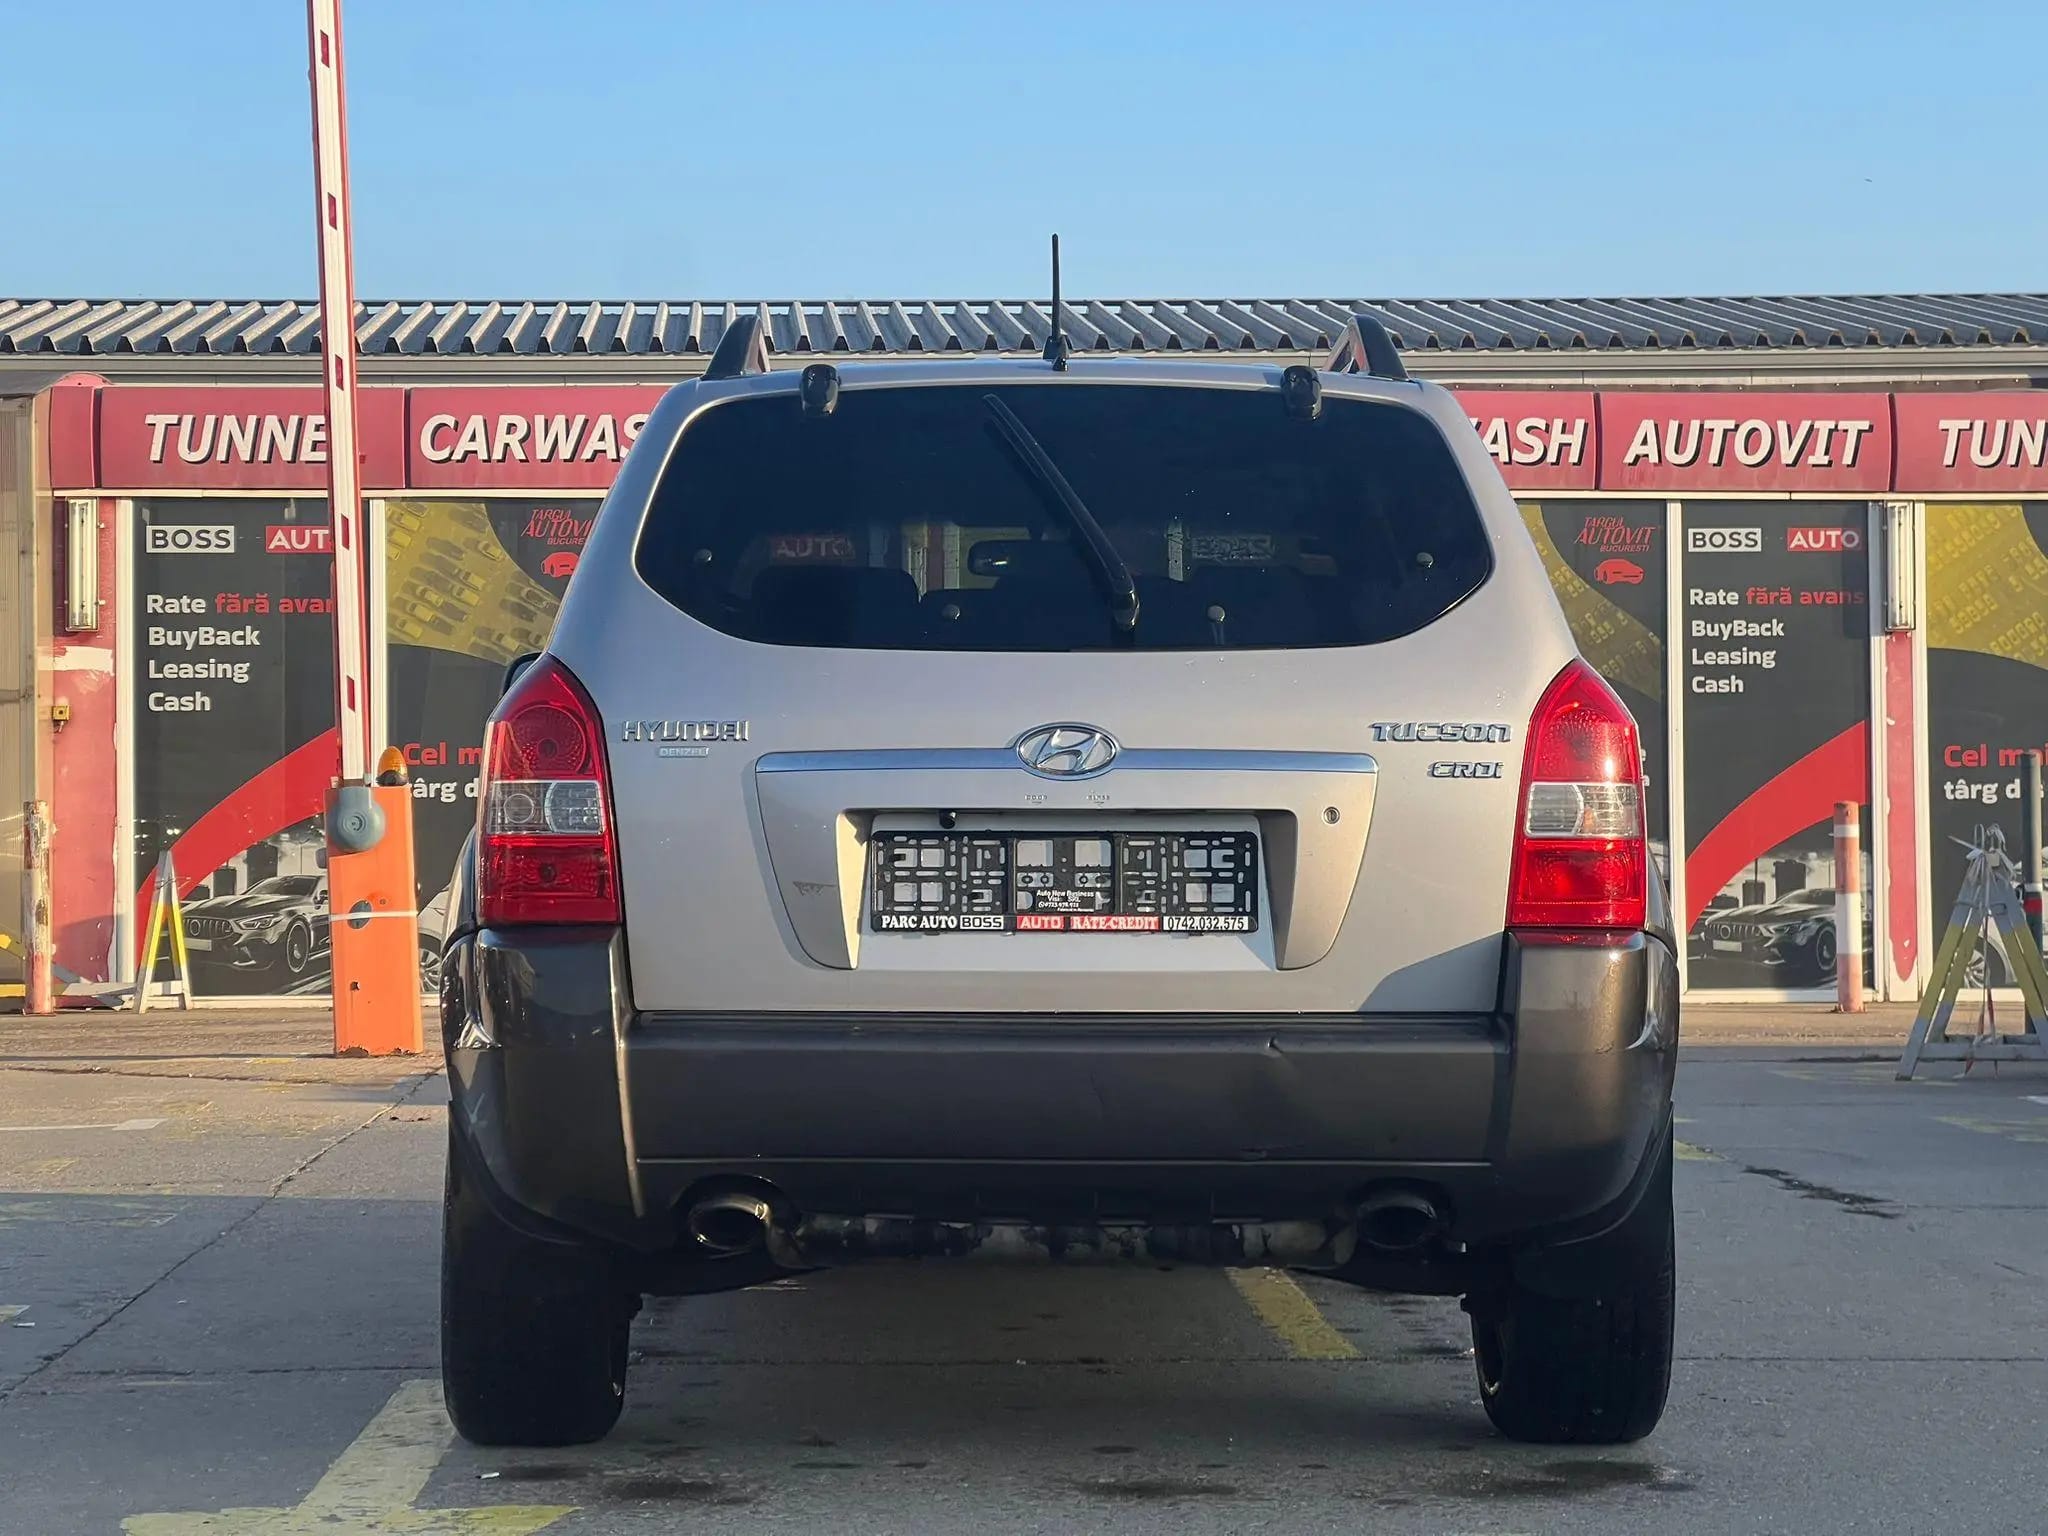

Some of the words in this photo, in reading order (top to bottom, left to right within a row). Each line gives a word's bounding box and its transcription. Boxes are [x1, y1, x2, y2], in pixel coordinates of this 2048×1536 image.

[145, 414, 328, 464] TUNNE
[1470, 417, 1588, 466] ASH
[1622, 419, 1874, 467] AUTOVIT
[1938, 419, 2048, 468] TUN
[521, 519, 592, 538] AUTOVI
[1573, 527, 1656, 545] AUTOVIT
[151, 529, 231, 549] BOSS
[268, 529, 329, 550] AUT
[547, 537, 585, 545] BUCURE
[1692, 531, 1758, 548] BOSS
[1789, 530, 1859, 549] AUTO
[147, 594, 206, 614] Rate
[215, 592, 269, 614] fără
[1690, 588, 1739, 606] Rate
[1746, 586, 1792, 606] fără
[1800, 591, 1865, 606] avans
[148, 626, 260, 650] BuyBack
[1691, 619, 1784, 640] BuyBack
[1692, 647, 1776, 669] Leasing
[149, 659, 250, 683] Leasing
[1692, 675, 1744, 693] Cash
[148, 691, 211, 711] Cash
[622, 720, 750, 741] HYUNDAI
[1369, 722, 1513, 742] TUCSON
[403, 742, 446, 766] Cel
[1944, 743, 1986, 767] Cel
[1944, 778, 1998, 804] târg
[881, 915, 917, 929] PARC
[919, 915, 957, 929] AUTO
[962, 916, 1002, 928] BOSS
[1020, 916, 1062, 929] AUTO
[1167, 916, 1244, 929] 0742.032.575
